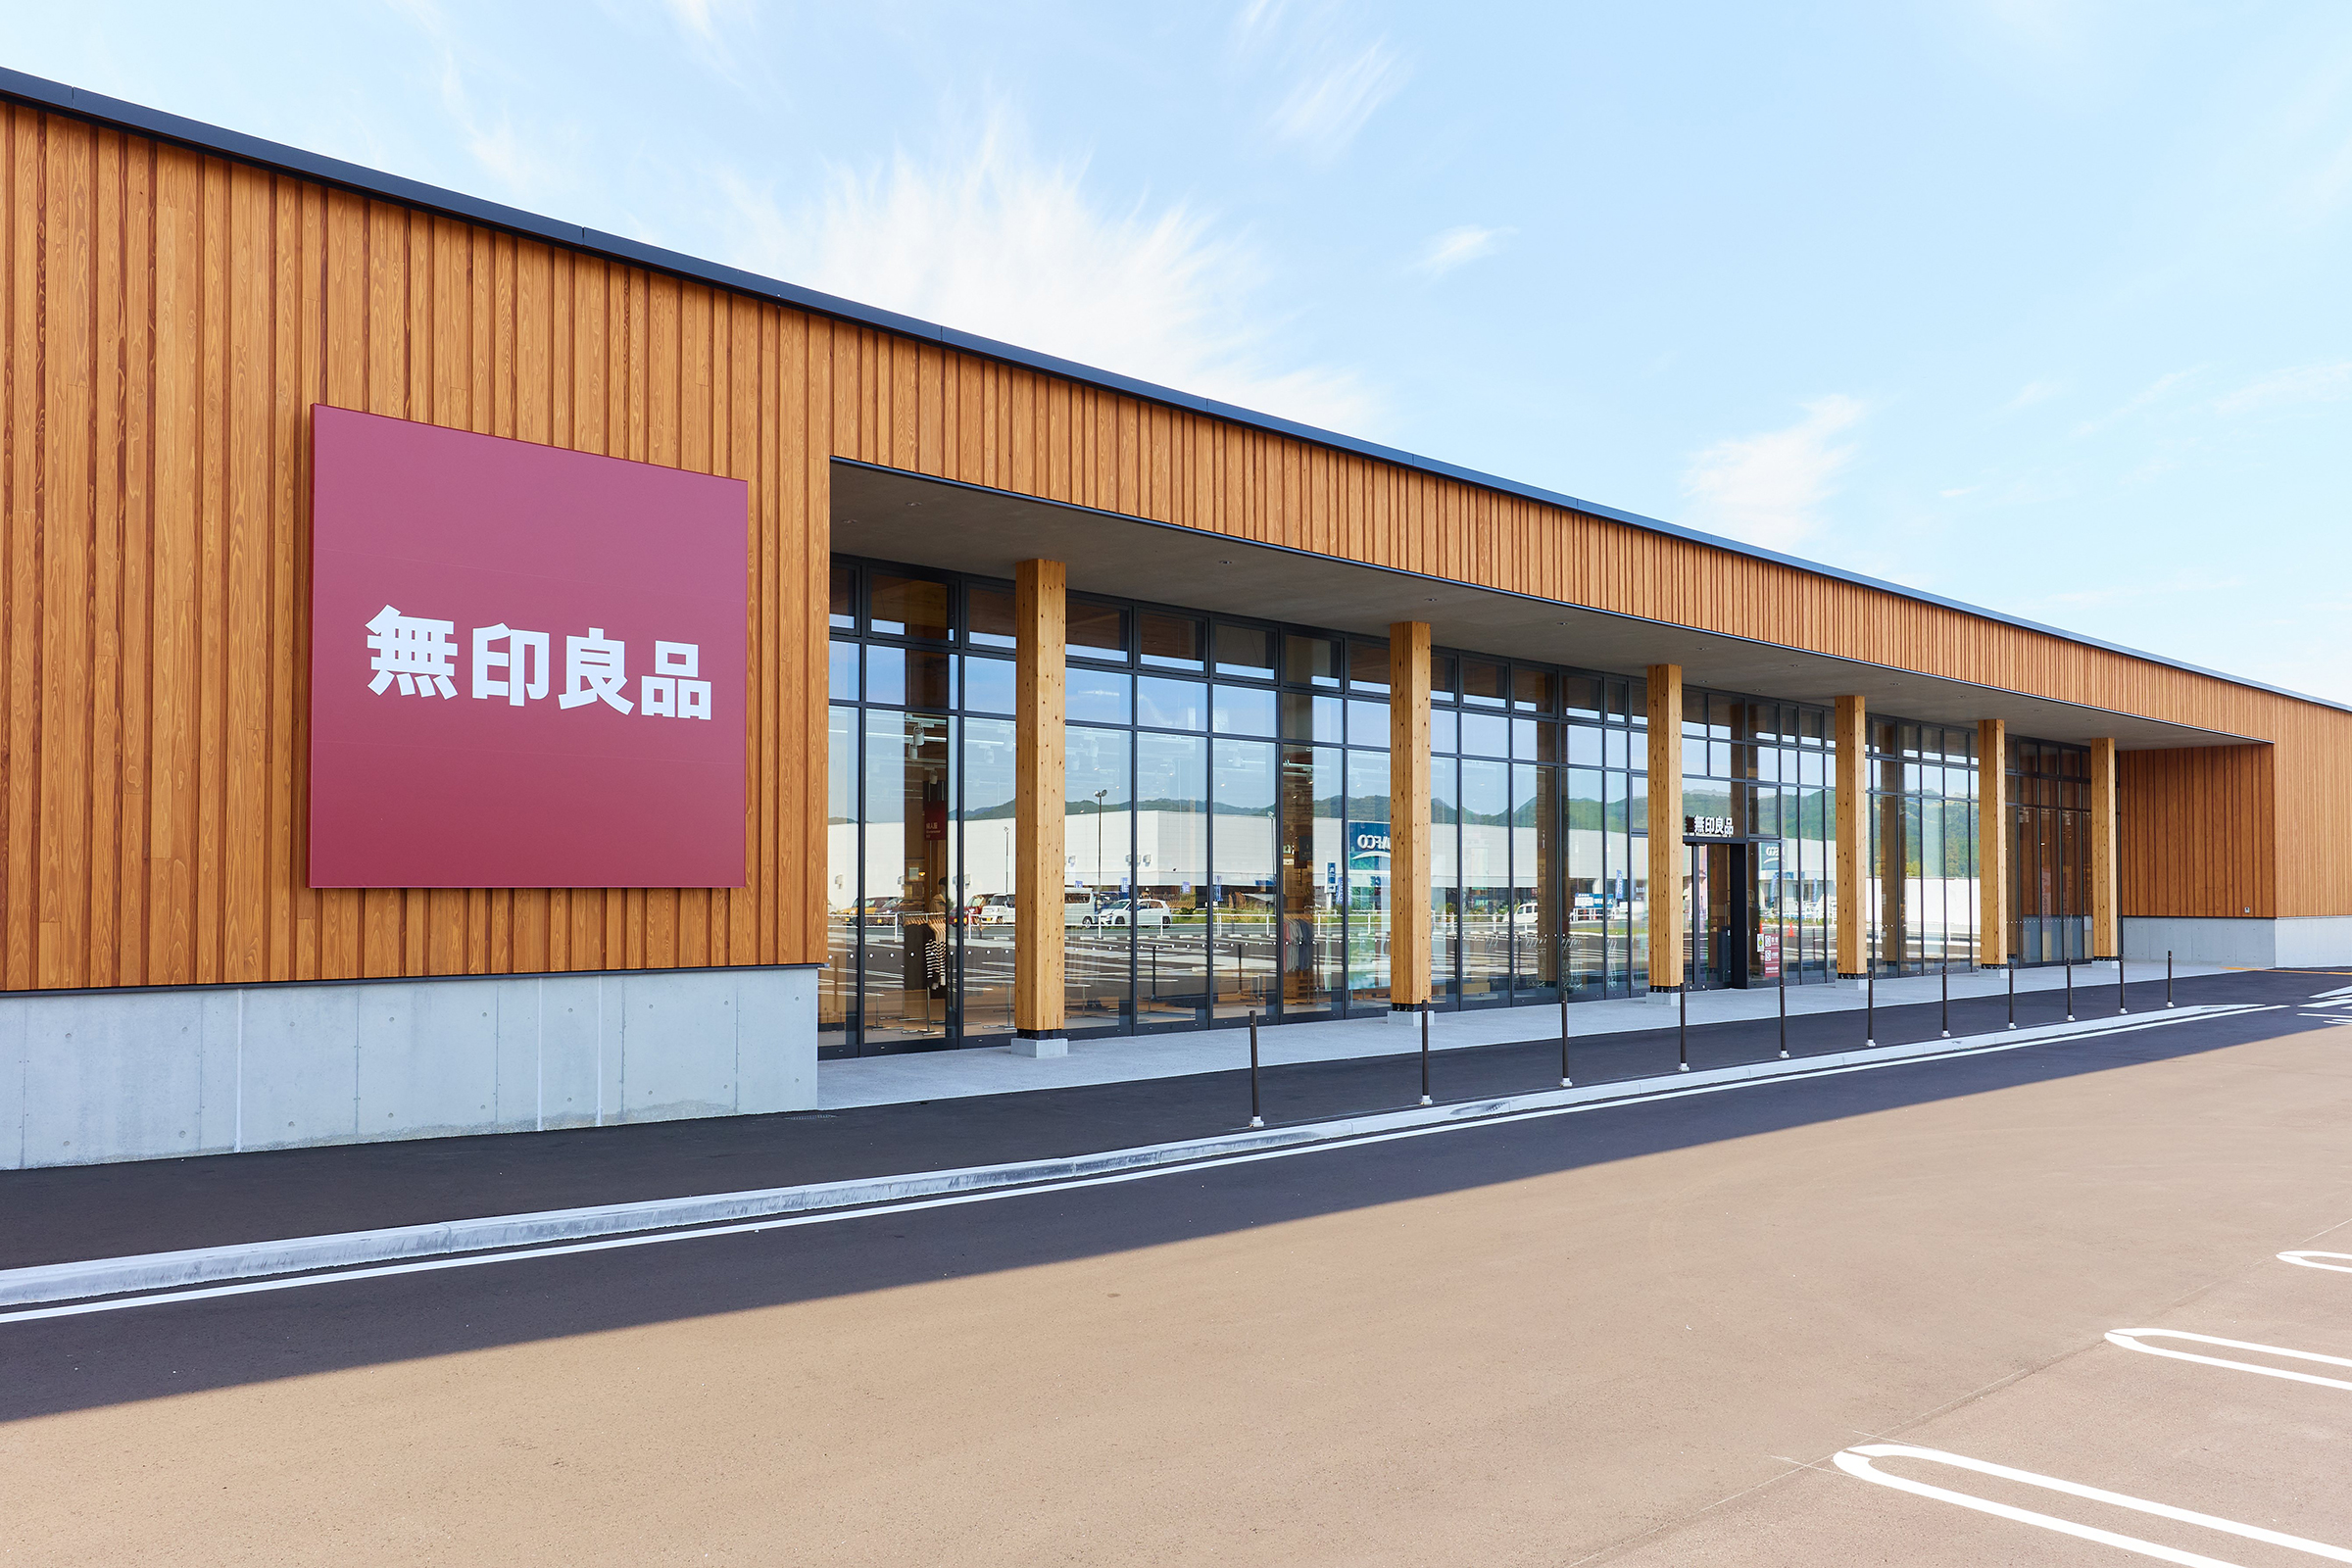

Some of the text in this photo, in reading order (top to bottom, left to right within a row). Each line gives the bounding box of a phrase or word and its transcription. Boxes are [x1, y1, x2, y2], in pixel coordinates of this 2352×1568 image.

[366, 604, 711, 720] 無印良品
[1694, 814, 1734, 835] 無印良品
